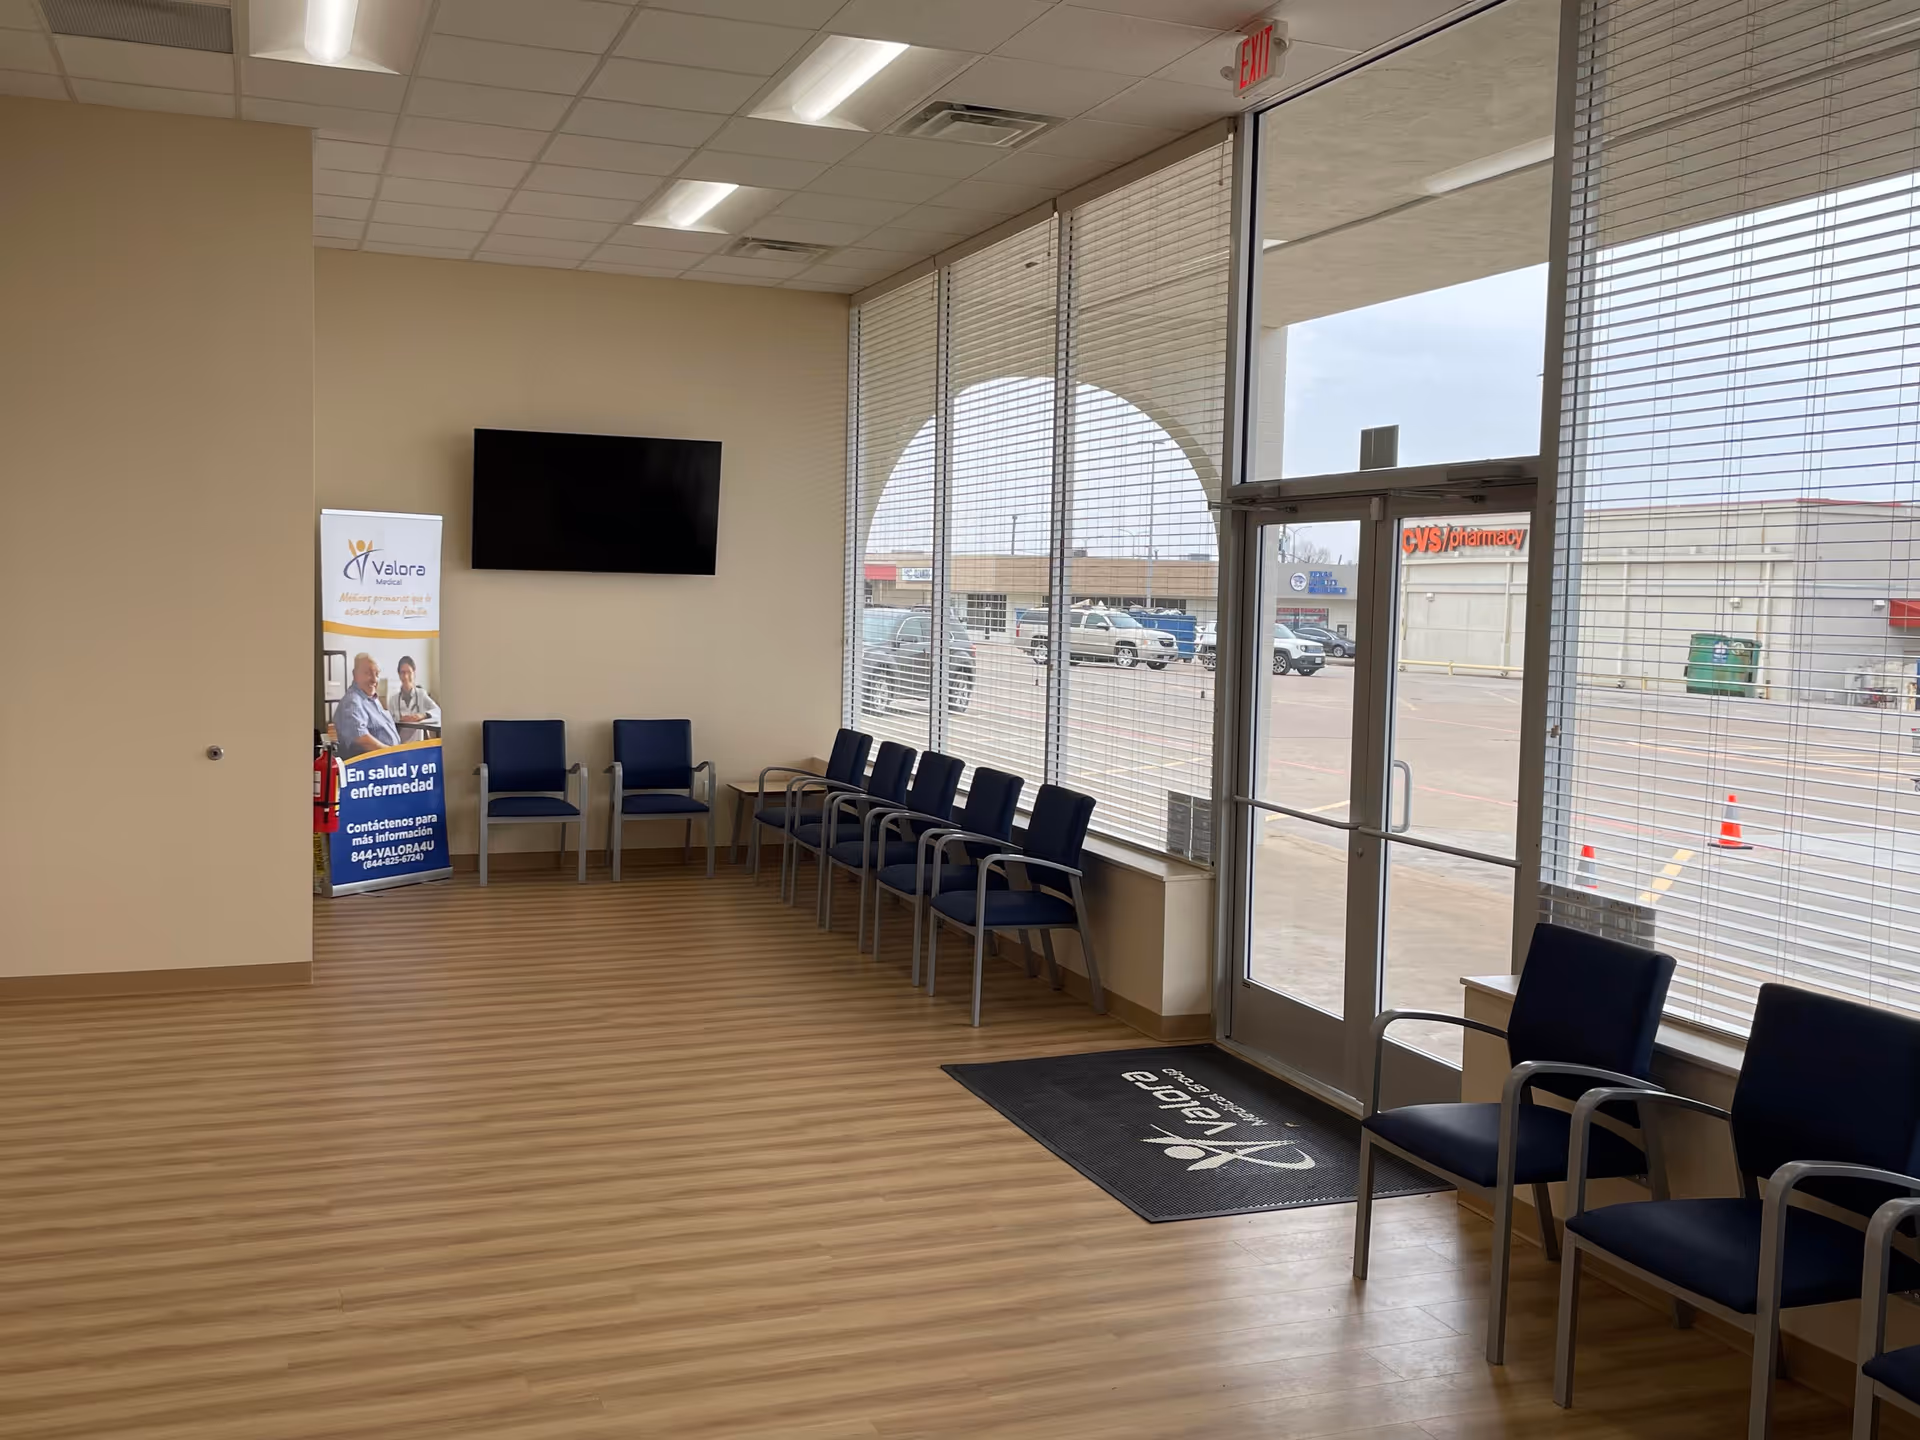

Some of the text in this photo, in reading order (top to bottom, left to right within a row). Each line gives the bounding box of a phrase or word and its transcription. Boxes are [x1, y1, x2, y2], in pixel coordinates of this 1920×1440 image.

[1240, 25, 1273, 89] EXIT
[372, 560, 426, 577] Valora
[375, 578, 403, 586] Medical
[347, 762, 437, 783] En salud y en
[350, 777, 434, 800] enfermedad
[346, 813, 438, 834] Contáctenos para
[352, 826, 433, 846] más información
[351, 840, 435, 863] 844-VALORA4U
[363, 852, 424, 870] (844-825-6724)
[1162, 1068, 1210, 1093] Group
[1121, 1070, 1237, 1136] Valora
